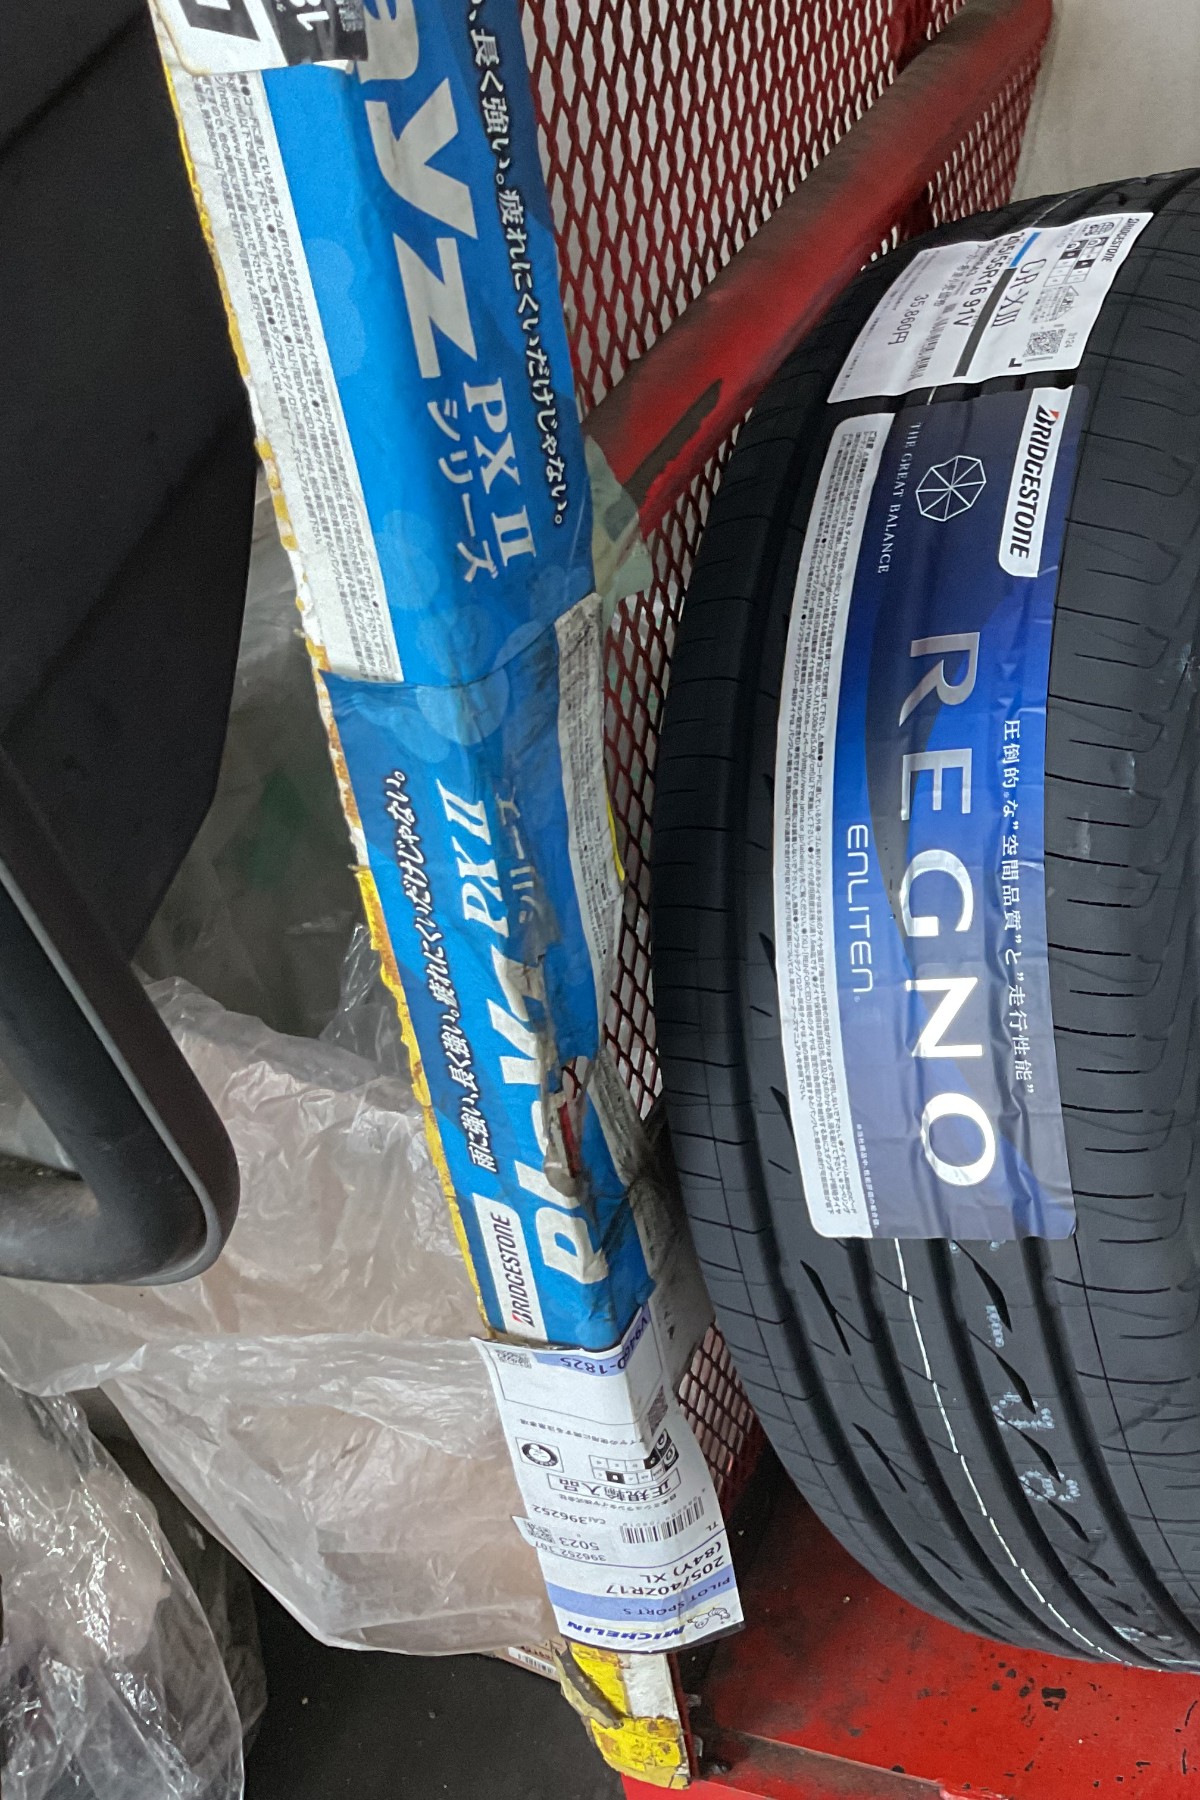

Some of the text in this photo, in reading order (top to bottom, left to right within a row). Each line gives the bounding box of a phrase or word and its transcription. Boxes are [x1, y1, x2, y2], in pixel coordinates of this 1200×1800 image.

[1102, 217, 1140, 263] BRIDGESTONE
[953, 299, 982, 327] 91V
[463, 377, 520, 492] PX
[428, 400, 498, 585] シリーズ
[877, 422, 921, 575] THE GREAT BALANCE
[1010, 404, 1061, 560] BRIDGESTONE
[452, 836, 509, 938] PX
[846, 822, 874, 995] ENLITEN
[897, 632, 997, 1188] REGNO
[490, 1211, 535, 1328] BRIDGESTONE
[557, 1477, 672, 1503] 正規輸入品
[559, 1536, 600, 1552] 5023
[705, 1520, 719, 1533] TL
[605, 1555, 725, 1596] 205/40ZR17
[640, 1541, 723, 1584] (84Y) XL
[636, 1592, 688, 1616] SPORT
[688, 1576, 731, 1600] PILOT
[567, 1620, 686, 1641] MICHELIN
